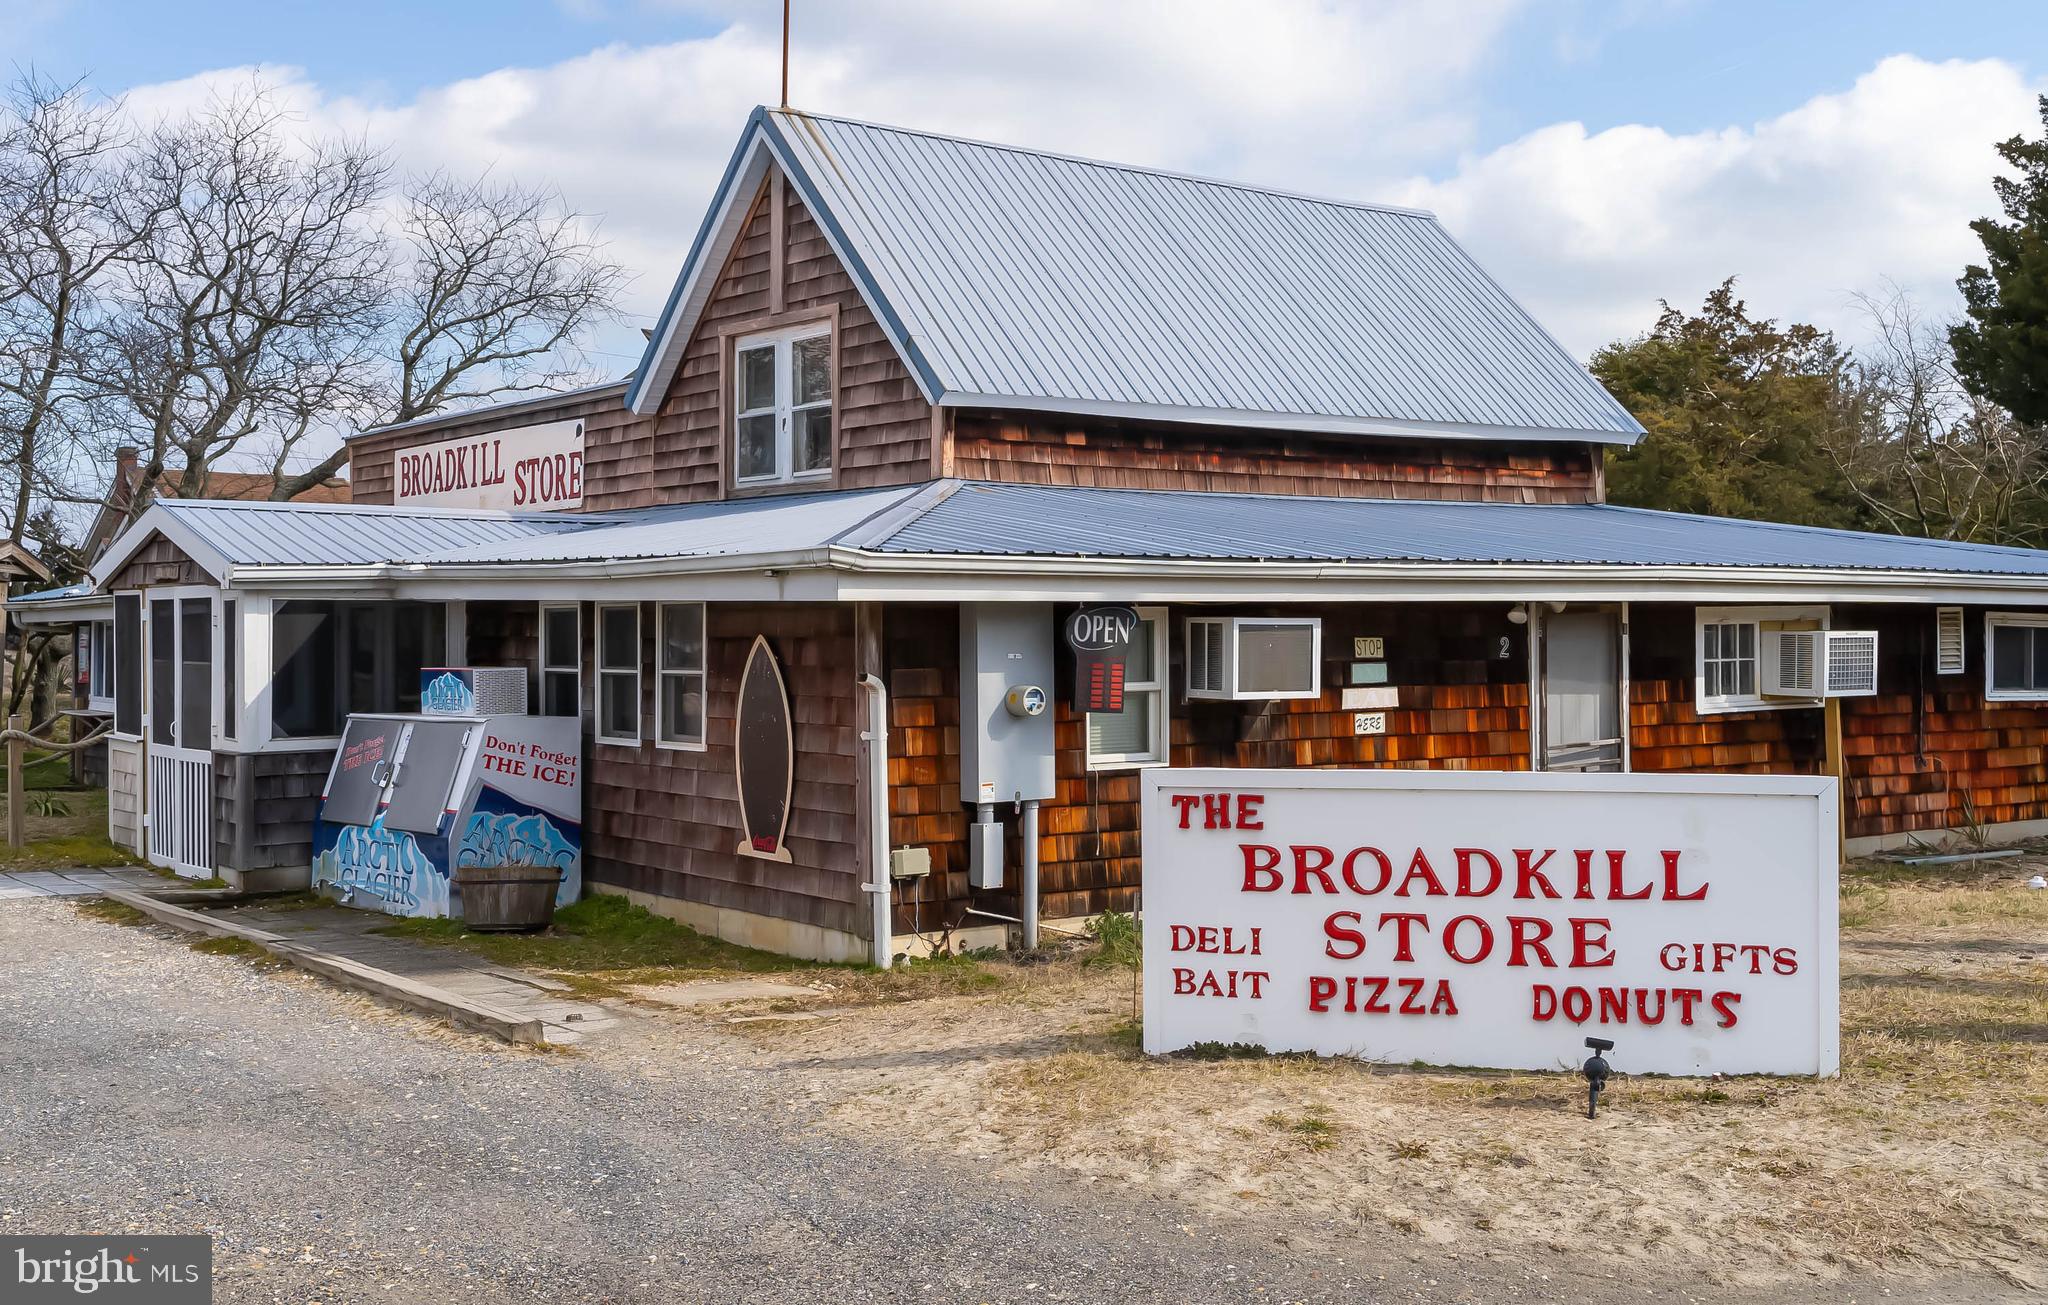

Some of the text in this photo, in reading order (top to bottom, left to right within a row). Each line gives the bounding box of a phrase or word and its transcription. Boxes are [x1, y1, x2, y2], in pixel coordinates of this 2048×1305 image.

[400, 440, 583, 505] BROADKILL STORE
[1073, 614, 1130, 644] OPEN
[1356, 639, 1382, 656] STOP
[1499, 636, 1510, 658] 2
[1356, 716, 1382, 731] HERE
[486, 735, 577, 767] Don't Forget
[482, 753, 576, 787] THE ICE!
[1171, 794, 1265, 831] THE
[341, 829, 414, 875] ARCTIC
[1241, 845, 1709, 901] BROADKILL
[1171, 925, 1263, 955] DELI
[1324, 912, 1614, 968] STORE
[1660, 944, 1798, 976] GIFTS
[1174, 968, 1269, 999] BAIT
[1310, 976, 1458, 1016] PIZZA
[1532, 984, 1742, 1029] DONUTS
